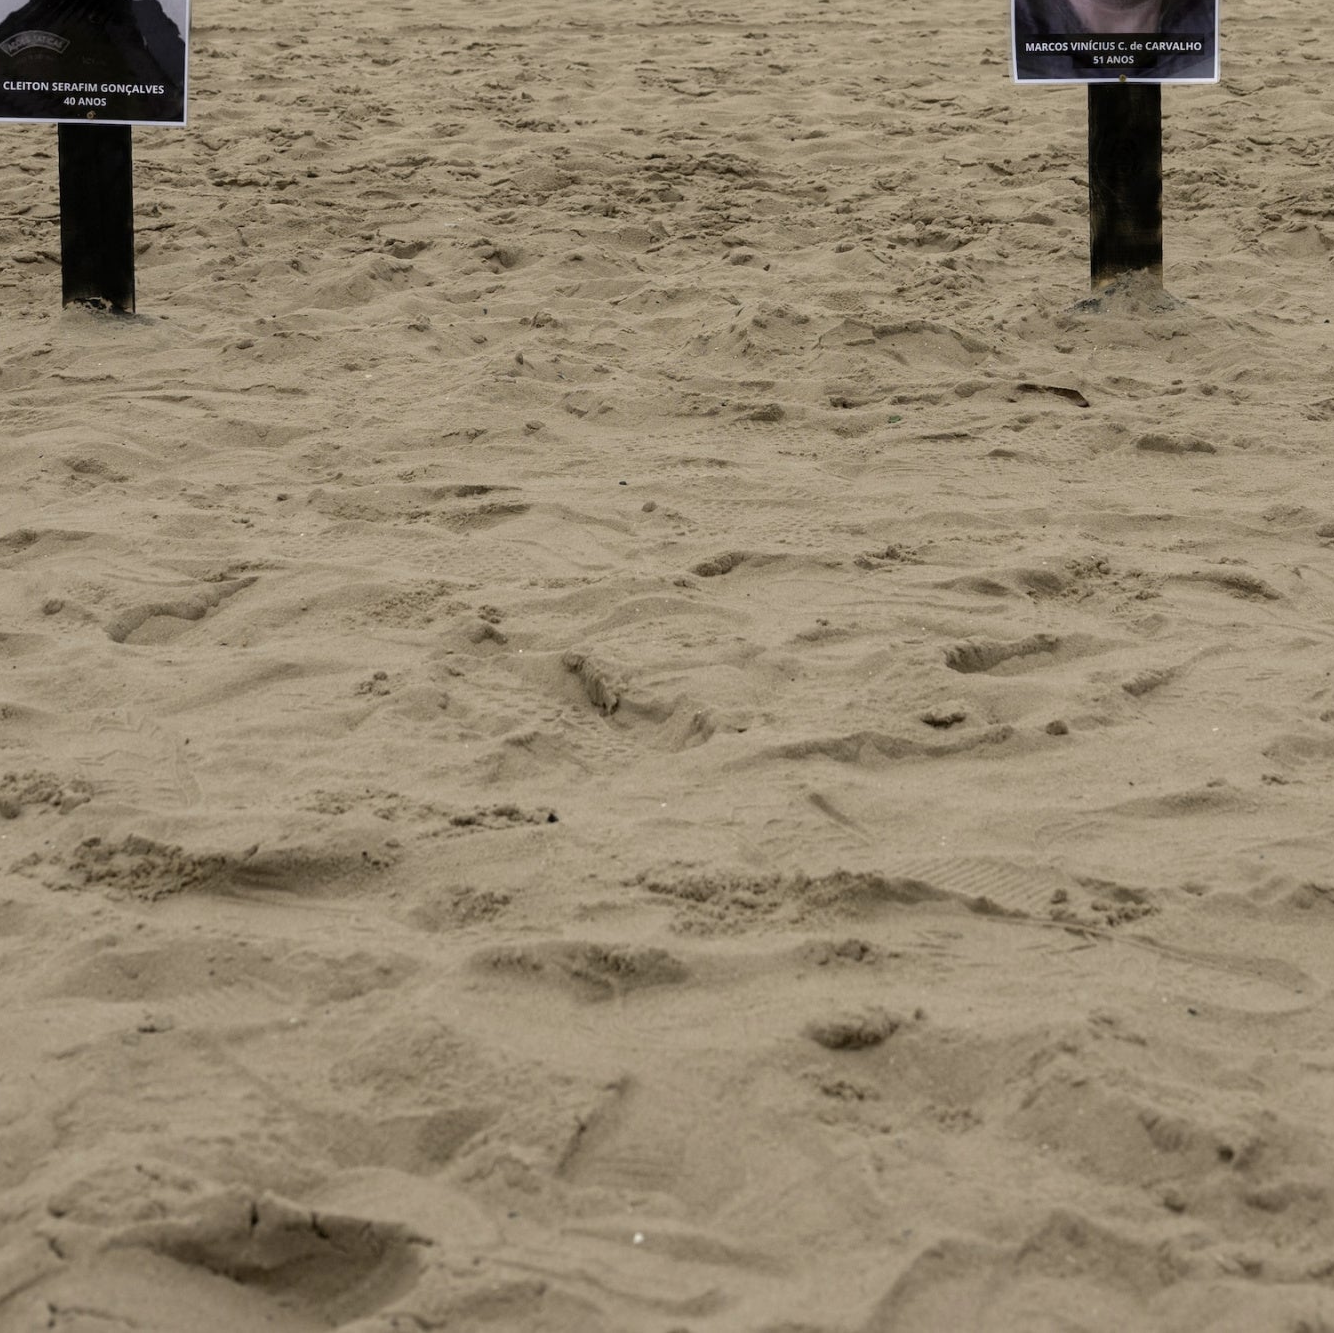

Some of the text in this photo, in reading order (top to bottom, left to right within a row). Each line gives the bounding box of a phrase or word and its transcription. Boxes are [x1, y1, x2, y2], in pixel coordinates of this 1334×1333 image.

[1025, 39, 1202, 52] MARCOS VINÍCIUS C. de CARVALHO
[1093, 55, 1135, 64] 51 ANOS
[3, 80, 165, 96] CLEITON SERAFIM GONÇALVES
[63, 97, 107, 107] 40 ANOS
